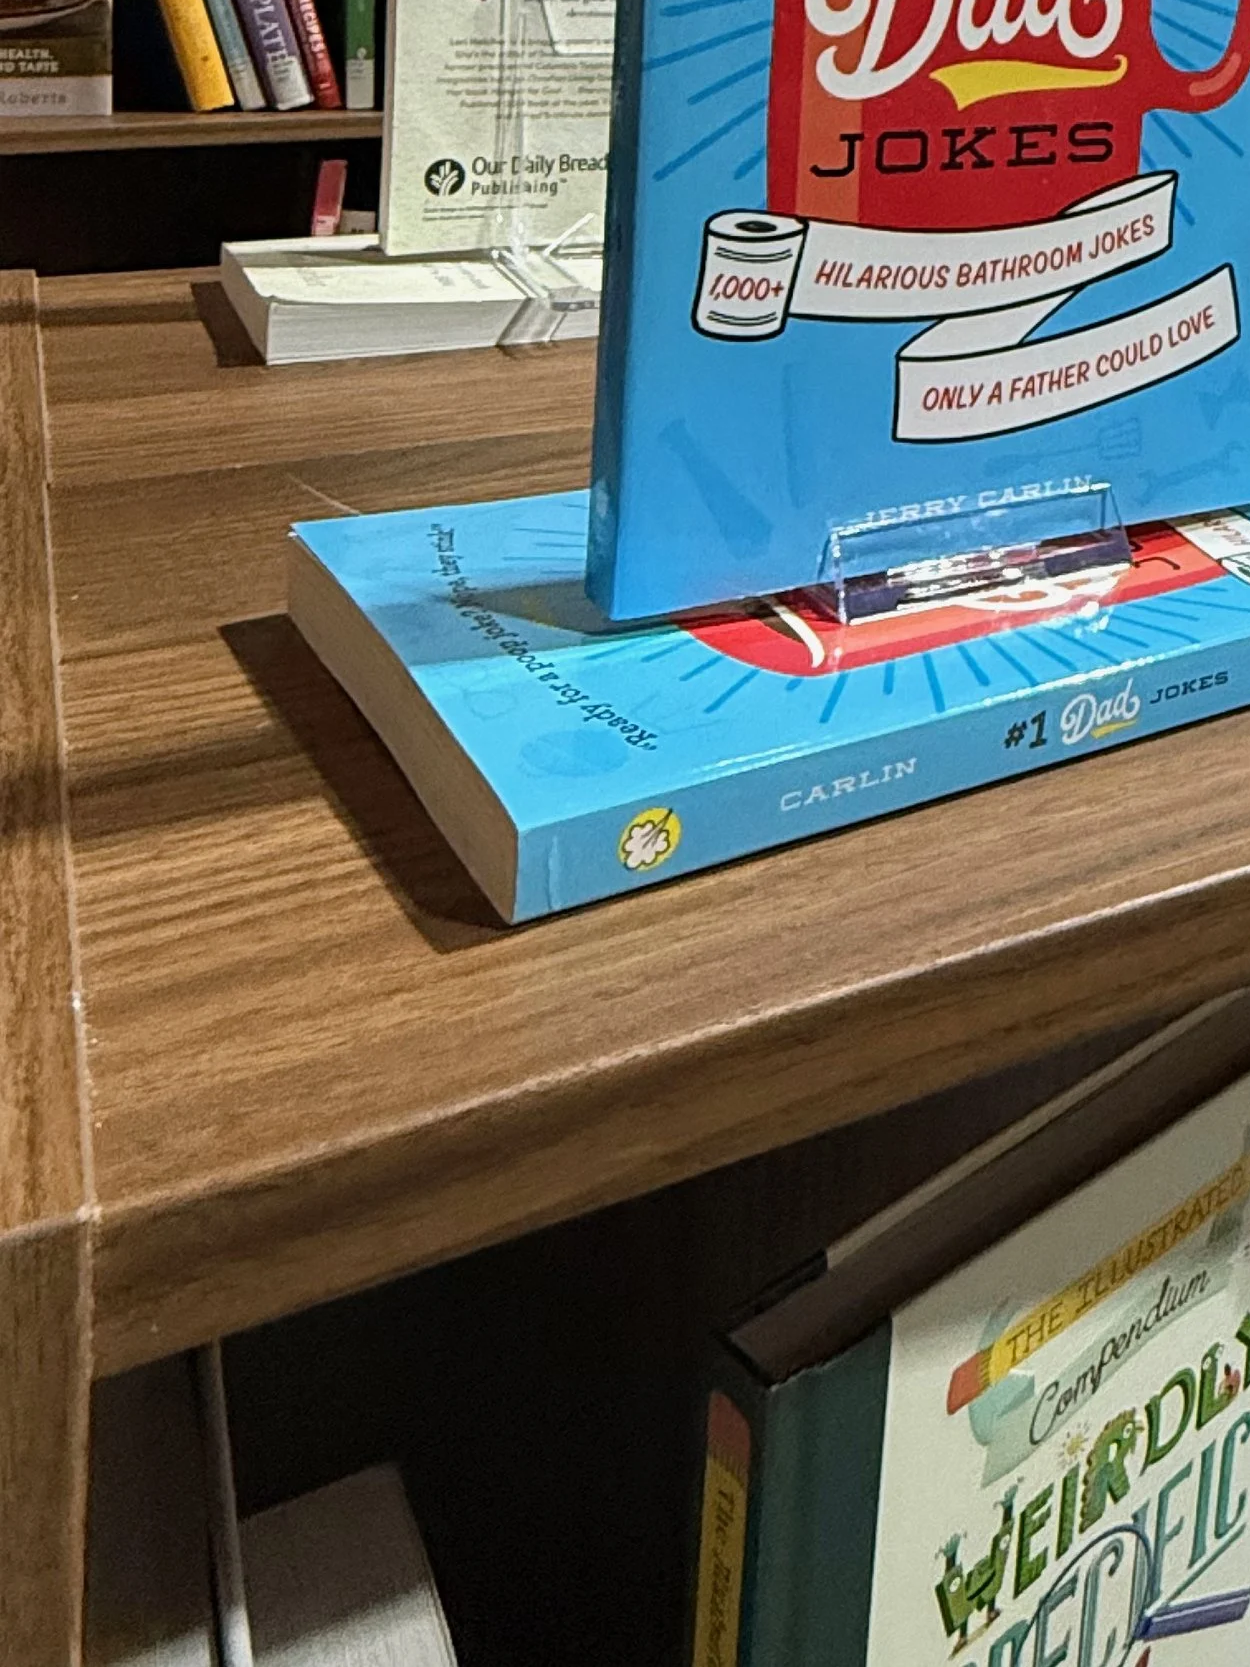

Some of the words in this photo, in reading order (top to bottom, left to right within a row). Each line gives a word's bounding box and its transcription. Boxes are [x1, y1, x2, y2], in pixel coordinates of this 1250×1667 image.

[471, 156, 508, 177] Our
[810, 121, 1116, 179] JOKES
[813, 258, 950, 292] HILARIOUS
[956, 239, 1085, 288] BATHROOM
[1087, 213, 1157, 263] JOKES
[708, 272, 786, 303] 1,000+
[921, 382, 985, 413] ONLY
[987, 380, 1004, 404] A
[1007, 360, 1092, 403] FATHER
[1095, 333, 1165, 379] COULD
[1166, 303, 1218, 350] LOVE
[864, 494, 968, 526] JERRY
[976, 473, 1094, 510] CARLIN
[459, 607, 519, 641] joke?
[498, 638, 556, 674] poop
[537, 671, 559, 684] a
[548, 682, 591, 707] for
[1002, 709, 1049, 753] #1
[1058, 675, 1143, 747] Dad
[1148, 669, 1231, 706] JOKES
[580, 701, 659, 752] “Ready
[779, 754, 917, 814] CARLIN
[1004, 1307, 1066, 1366] THE
[1075, 1164, 1246, 1311] ILLUSTRATED
[1028, 1266, 1215, 1447] Compendium
